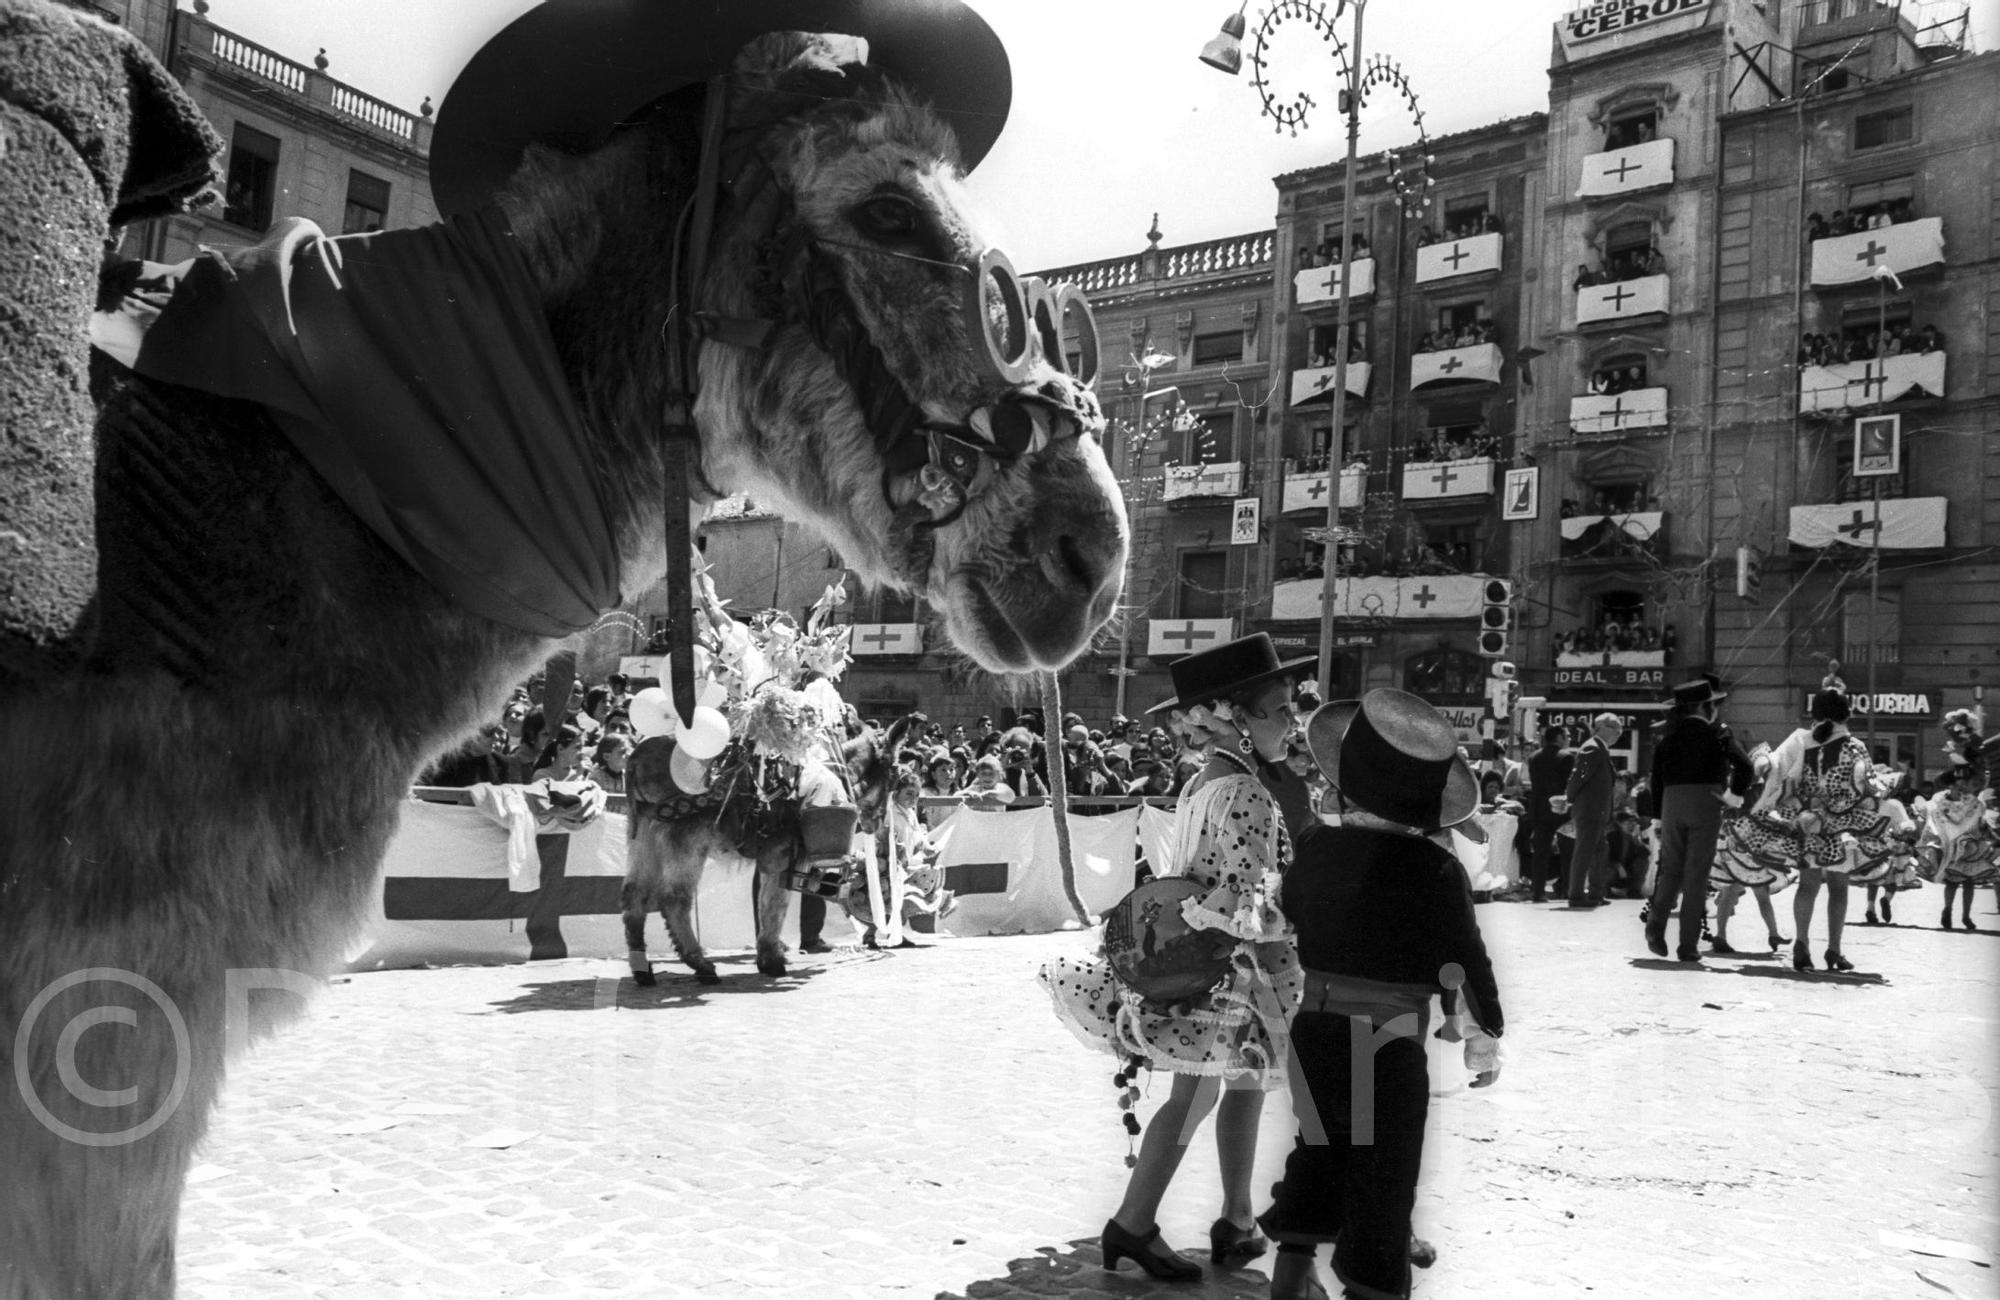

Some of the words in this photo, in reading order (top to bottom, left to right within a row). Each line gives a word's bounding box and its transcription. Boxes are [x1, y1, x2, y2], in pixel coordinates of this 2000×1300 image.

[1554, 671, 1608, 683] IDEAL
[1625, 671, 1664, 683] BAR
[1806, 693, 1931, 714] UQUERIA
